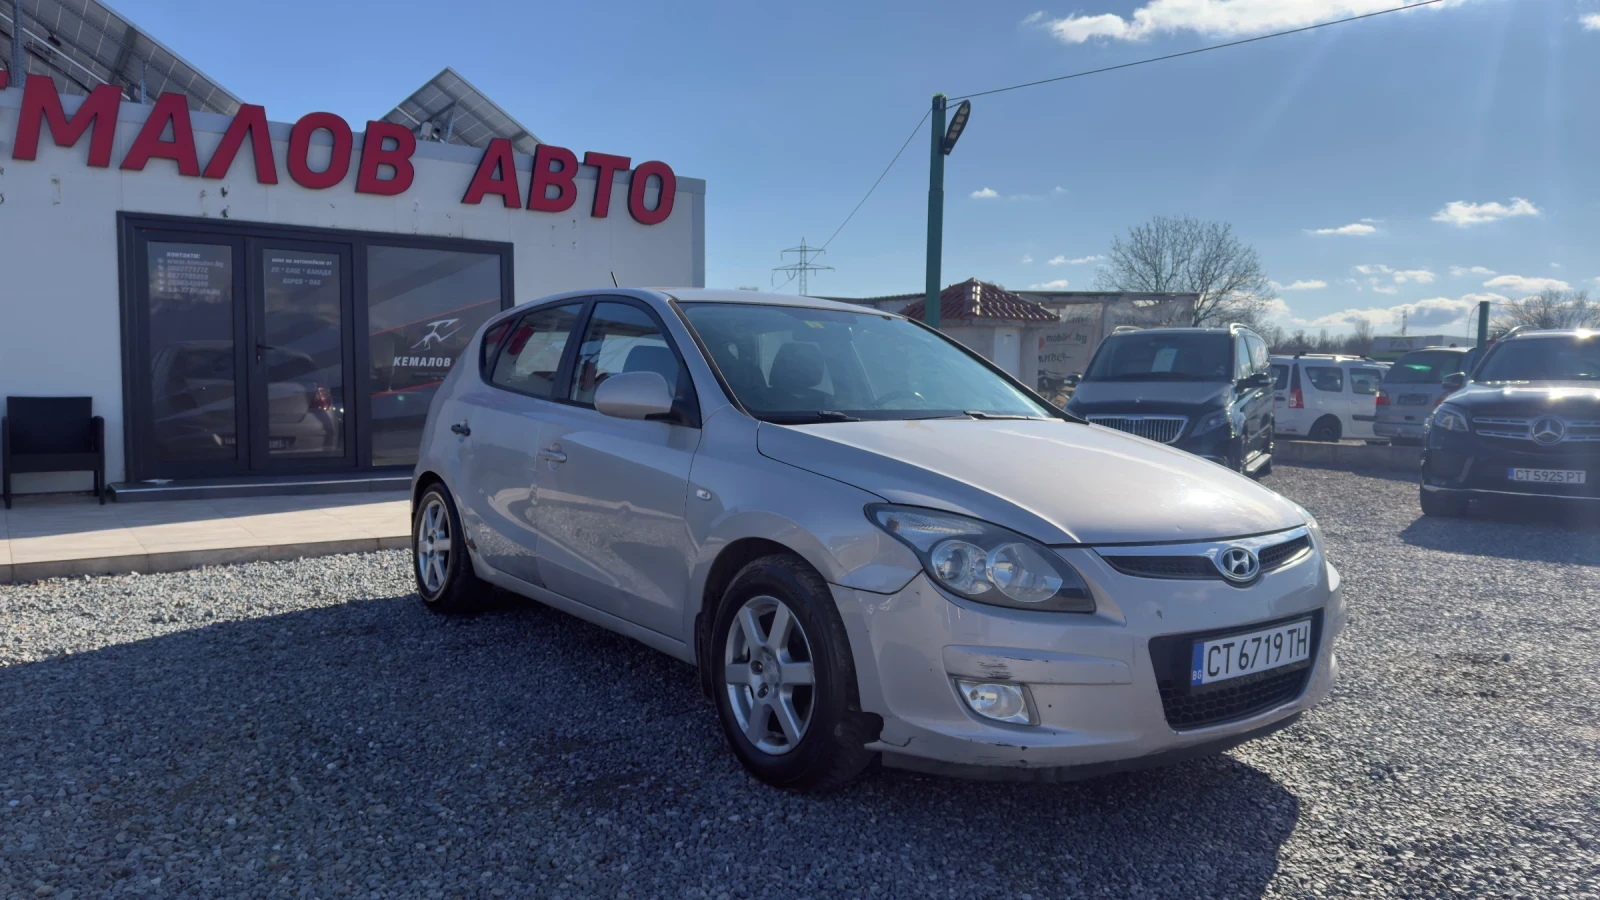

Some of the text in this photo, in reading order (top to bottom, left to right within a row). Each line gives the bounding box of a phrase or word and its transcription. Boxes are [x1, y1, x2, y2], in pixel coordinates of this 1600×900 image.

[0, 70, 676, 225] МАЛОВ АВТО
[393, 356, 451, 367] КЕМАЛОВ
[1516, 470, 1583, 482] CT 5925 PT
[1207, 625, 1308, 677] CT 6719 TH
[1192, 670, 1203, 681] BG
